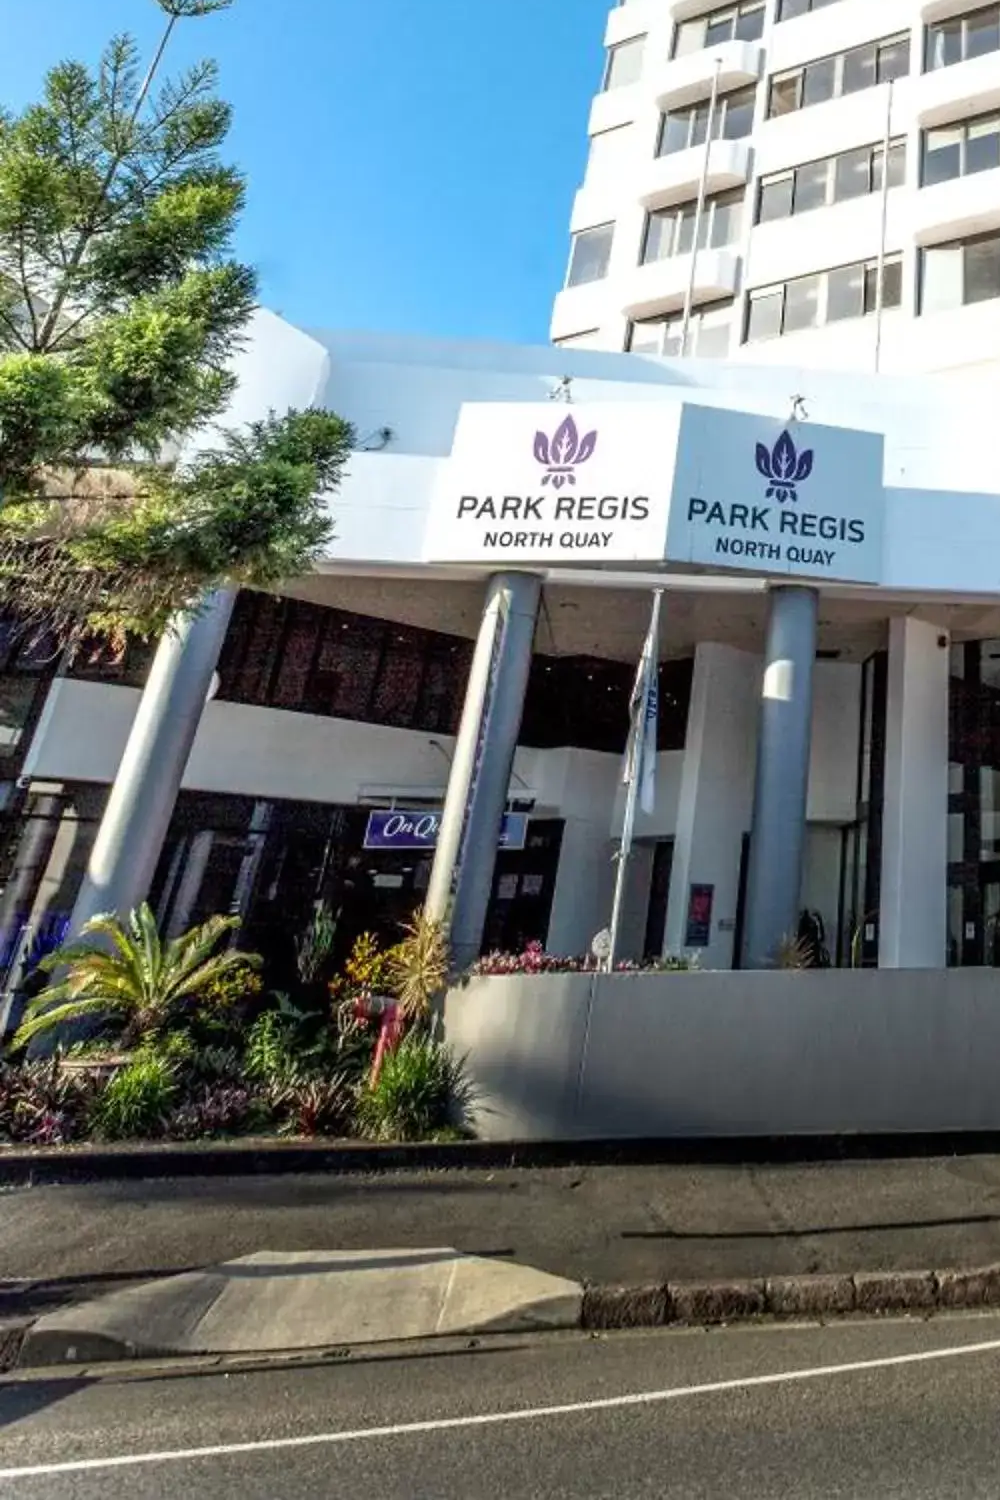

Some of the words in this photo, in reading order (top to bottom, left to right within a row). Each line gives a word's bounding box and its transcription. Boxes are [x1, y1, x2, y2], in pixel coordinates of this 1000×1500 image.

[456, 496, 545, 520] PARK
[554, 496, 650, 521] REGIS
[687, 497, 771, 532] PARK
[779, 510, 866, 544] REGIS
[483, 531, 554, 548] NORTH
[559, 531, 614, 549] QUAY
[715, 537, 781, 561] NORTH
[786, 546, 836, 567] QUAY
[383, 815, 413, 837] On
